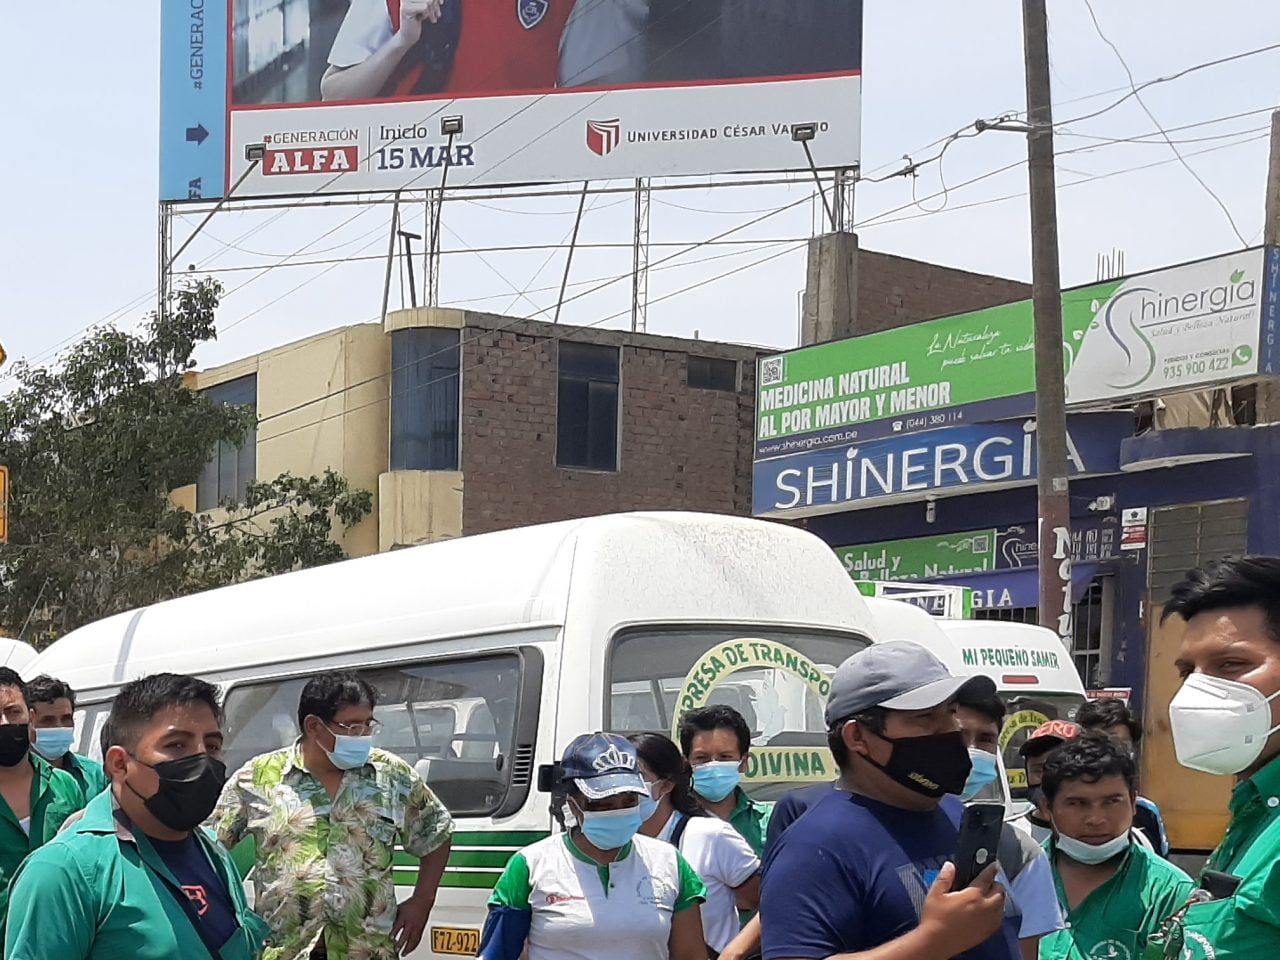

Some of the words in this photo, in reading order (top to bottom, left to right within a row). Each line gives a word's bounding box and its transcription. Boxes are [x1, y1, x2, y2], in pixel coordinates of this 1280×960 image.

[263, 129, 359, 145] #GENERACIÓN
[379, 124, 428, 141] Inicio
[627, 128, 718, 143] UNIVERSIDAD
[723, 123, 766, 138] CÉSAR
[270, 149, 350, 172] ALFA
[377, 148, 404, 170] 15
[409, 145, 475, 169] MAR
[1163, 364, 1182, 379] 935
[1186, 360, 1205, 376] 900
[1209, 356, 1229, 371] 422
[760, 376, 834, 411] MEDICINA
[838, 361, 910, 398] NATURAL
[759, 415, 777, 438] AL
[781, 408, 811, 434] POR
[815, 396, 870, 429] MAYOR
[875, 394, 887, 417] Y
[890, 381, 951, 415] MENOR
[929, 414, 946, 426] 380
[948, 411, 963, 423] 114
[844, 550, 886, 572] Salud
[891, 555, 901, 571] y
[722, 643, 749, 667] DE
[962, 648, 977, 665] MI
[981, 644, 1029, 667] PEQUEÑO
[1032, 649, 1060, 669] SAMIR
[745, 751, 826, 778] DIVINA
[433, 930, 477, 953] F7Z-922
